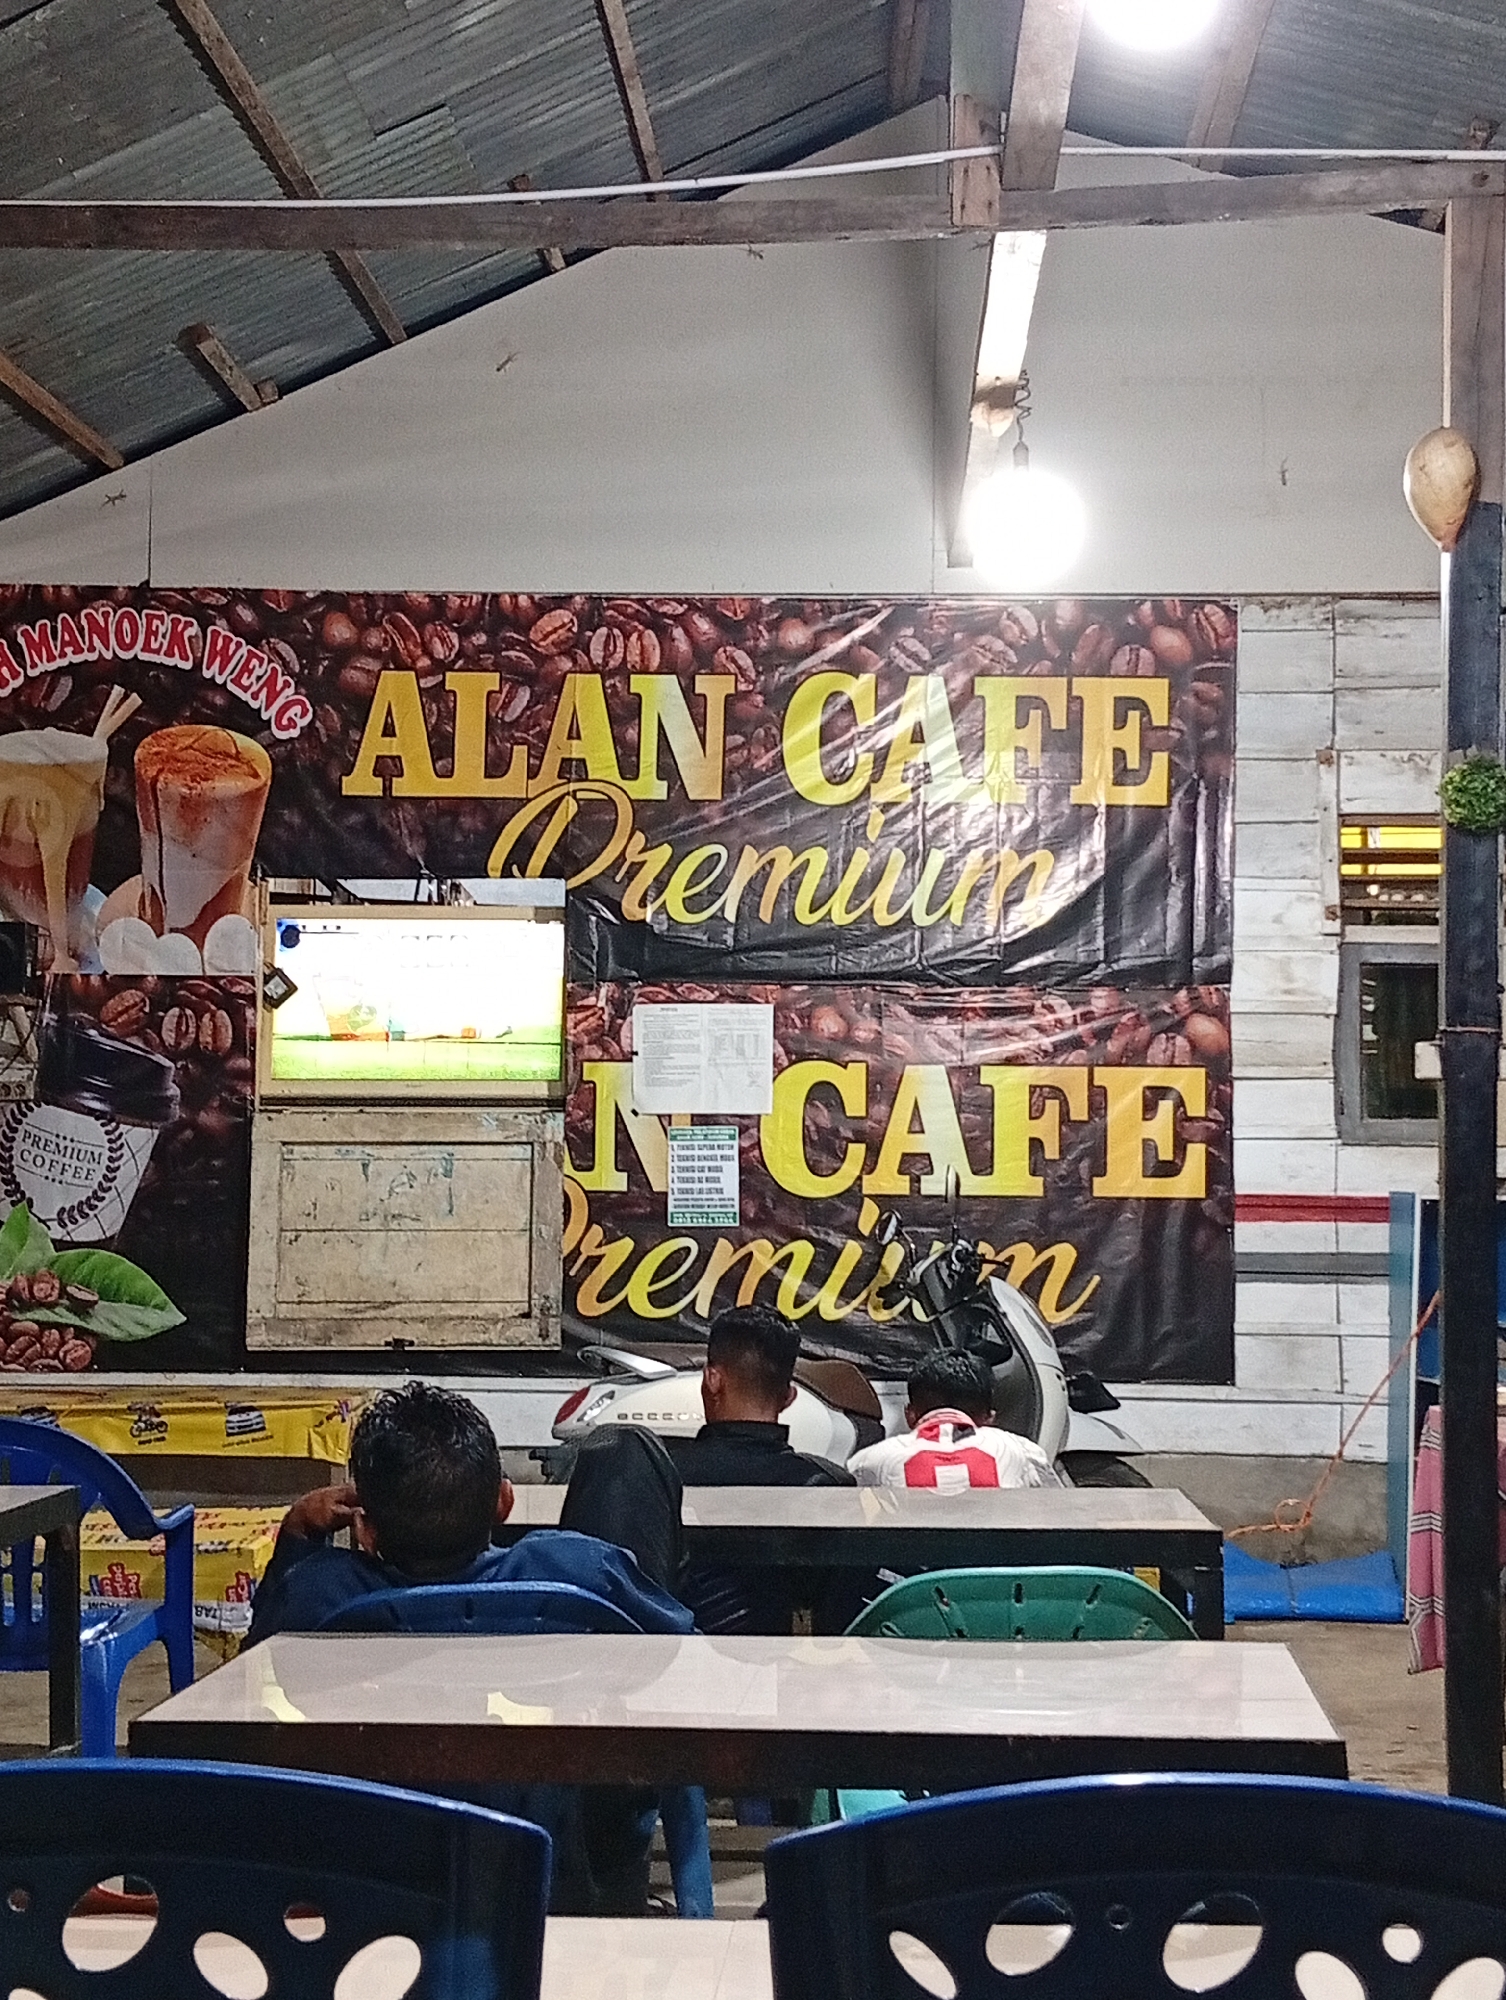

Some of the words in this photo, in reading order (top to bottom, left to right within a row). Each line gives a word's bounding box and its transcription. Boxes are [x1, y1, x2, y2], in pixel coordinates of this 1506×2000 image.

[19, 608, 194, 674] MANOEK
[202, 625, 314, 740] WENG
[341, 669, 737, 802] ALAN
[783, 670, 1170, 807] CAFE
[487, 779, 1062, 927] Premium
[19, 1148, 97, 1182] COFFEE
[21, 1128, 103, 1165] PREMIUM
[759, 1060, 1207, 1199] CAFE
